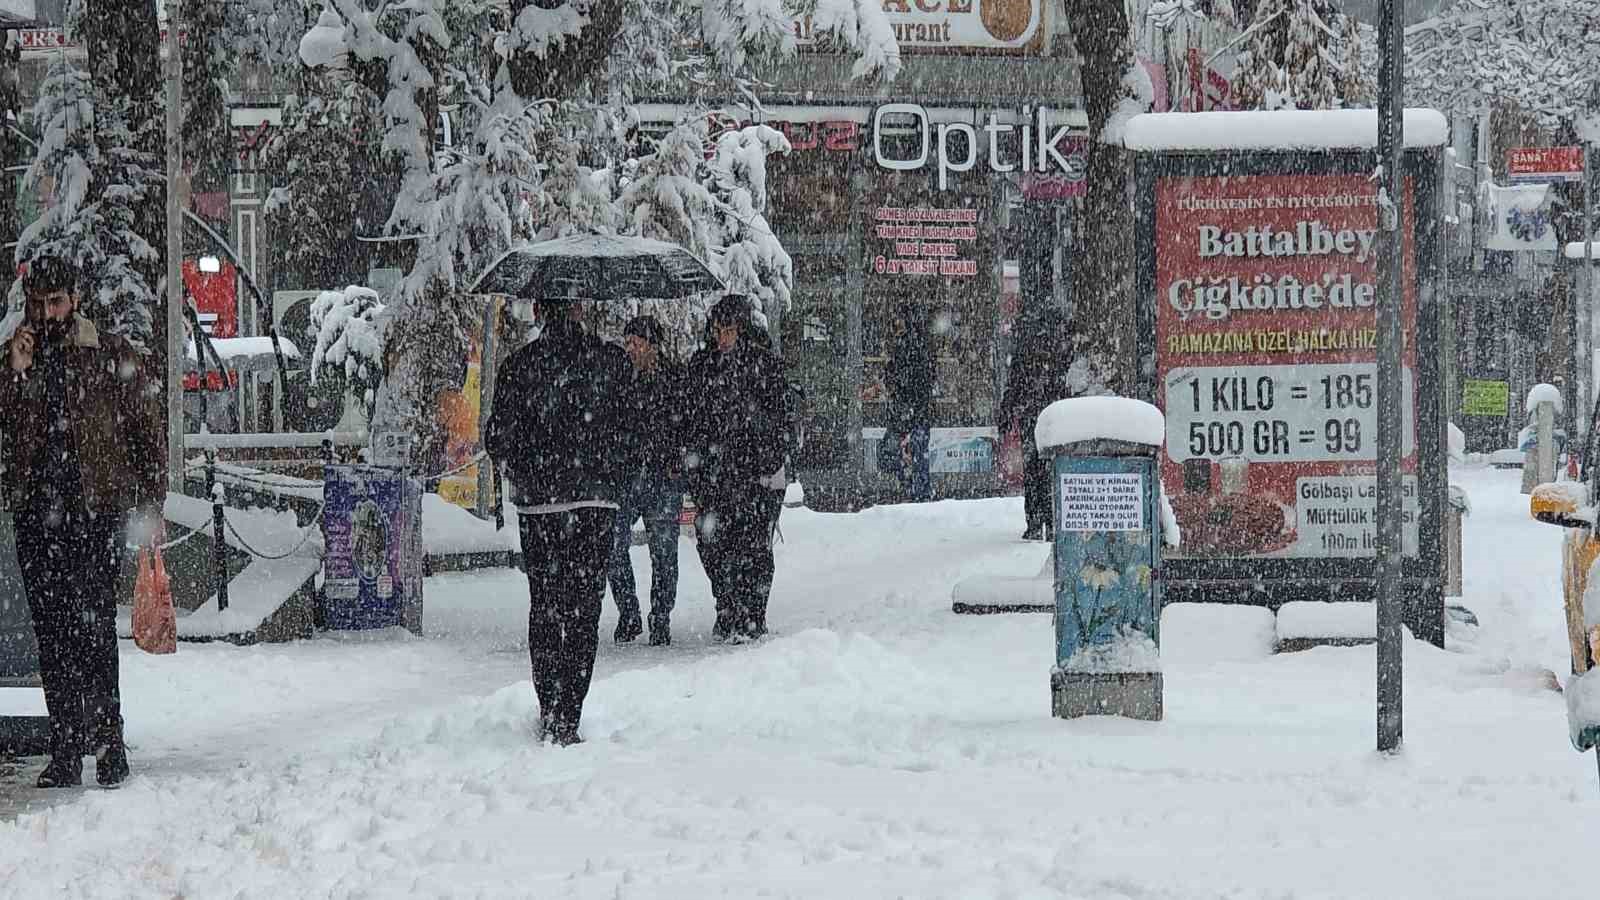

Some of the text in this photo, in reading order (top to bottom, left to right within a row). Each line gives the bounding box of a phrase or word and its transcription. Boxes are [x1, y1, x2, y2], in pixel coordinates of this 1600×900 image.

[891, 19, 951, 42] urant
[873, 103, 1073, 191] Optik
[896, 242, 919, 256] VADE
[1198, 221, 1377, 263] Battalbey
[875, 256, 886, 274] 6
[1168, 333, 1252, 353] RAMAZANA
[1299, 330, 1349, 352] HALKA
[1189, 377, 1201, 413] 1
[1212, 370, 1275, 412] KİLO
[1320, 374, 1373, 410] 185
[1189, 421, 1245, 457] 500
[1252, 419, 1290, 455] GR
[1324, 418, 1362, 454] 99
[1300, 481, 1415, 502] Gölbaşı Casi
[1306, 507, 1368, 525] Müftülük
